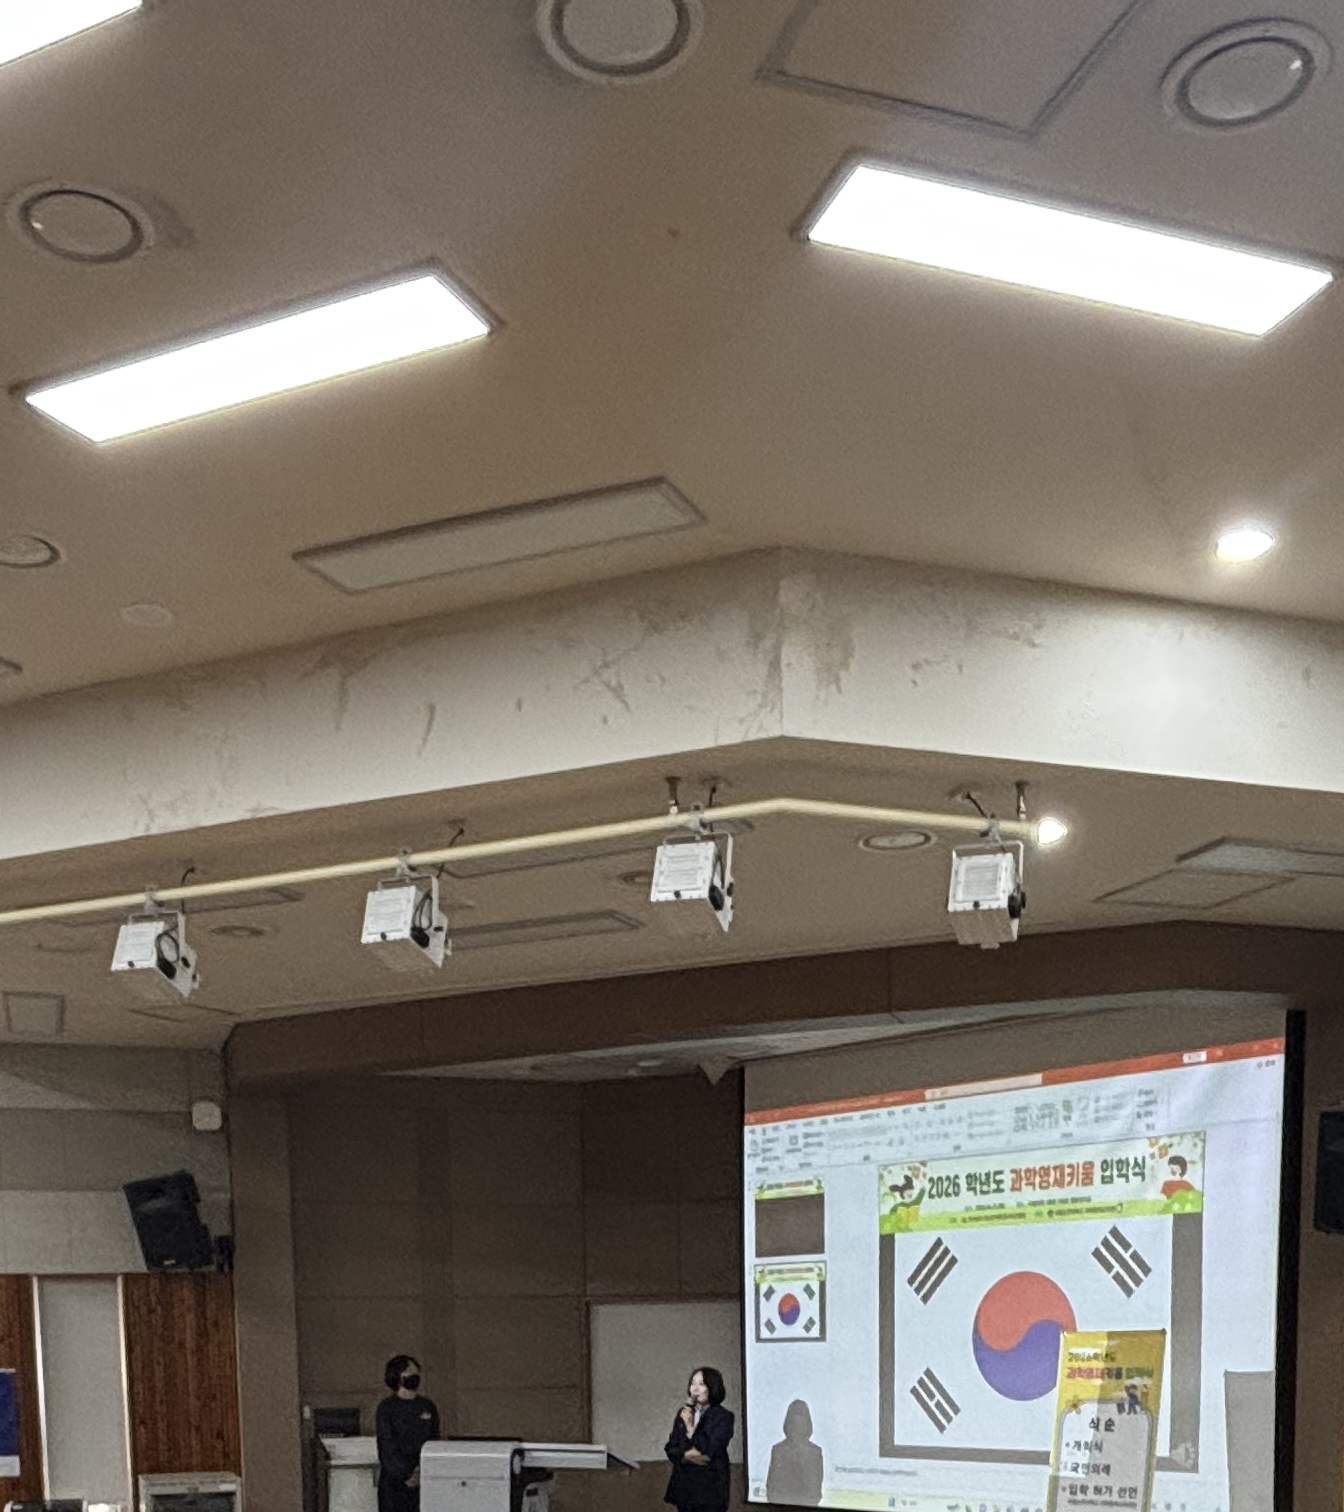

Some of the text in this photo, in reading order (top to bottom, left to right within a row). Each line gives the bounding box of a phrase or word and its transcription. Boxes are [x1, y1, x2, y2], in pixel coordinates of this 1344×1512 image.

[927, 1155, 1147, 1200] 2026 학년도 과학영재키움 입학식
